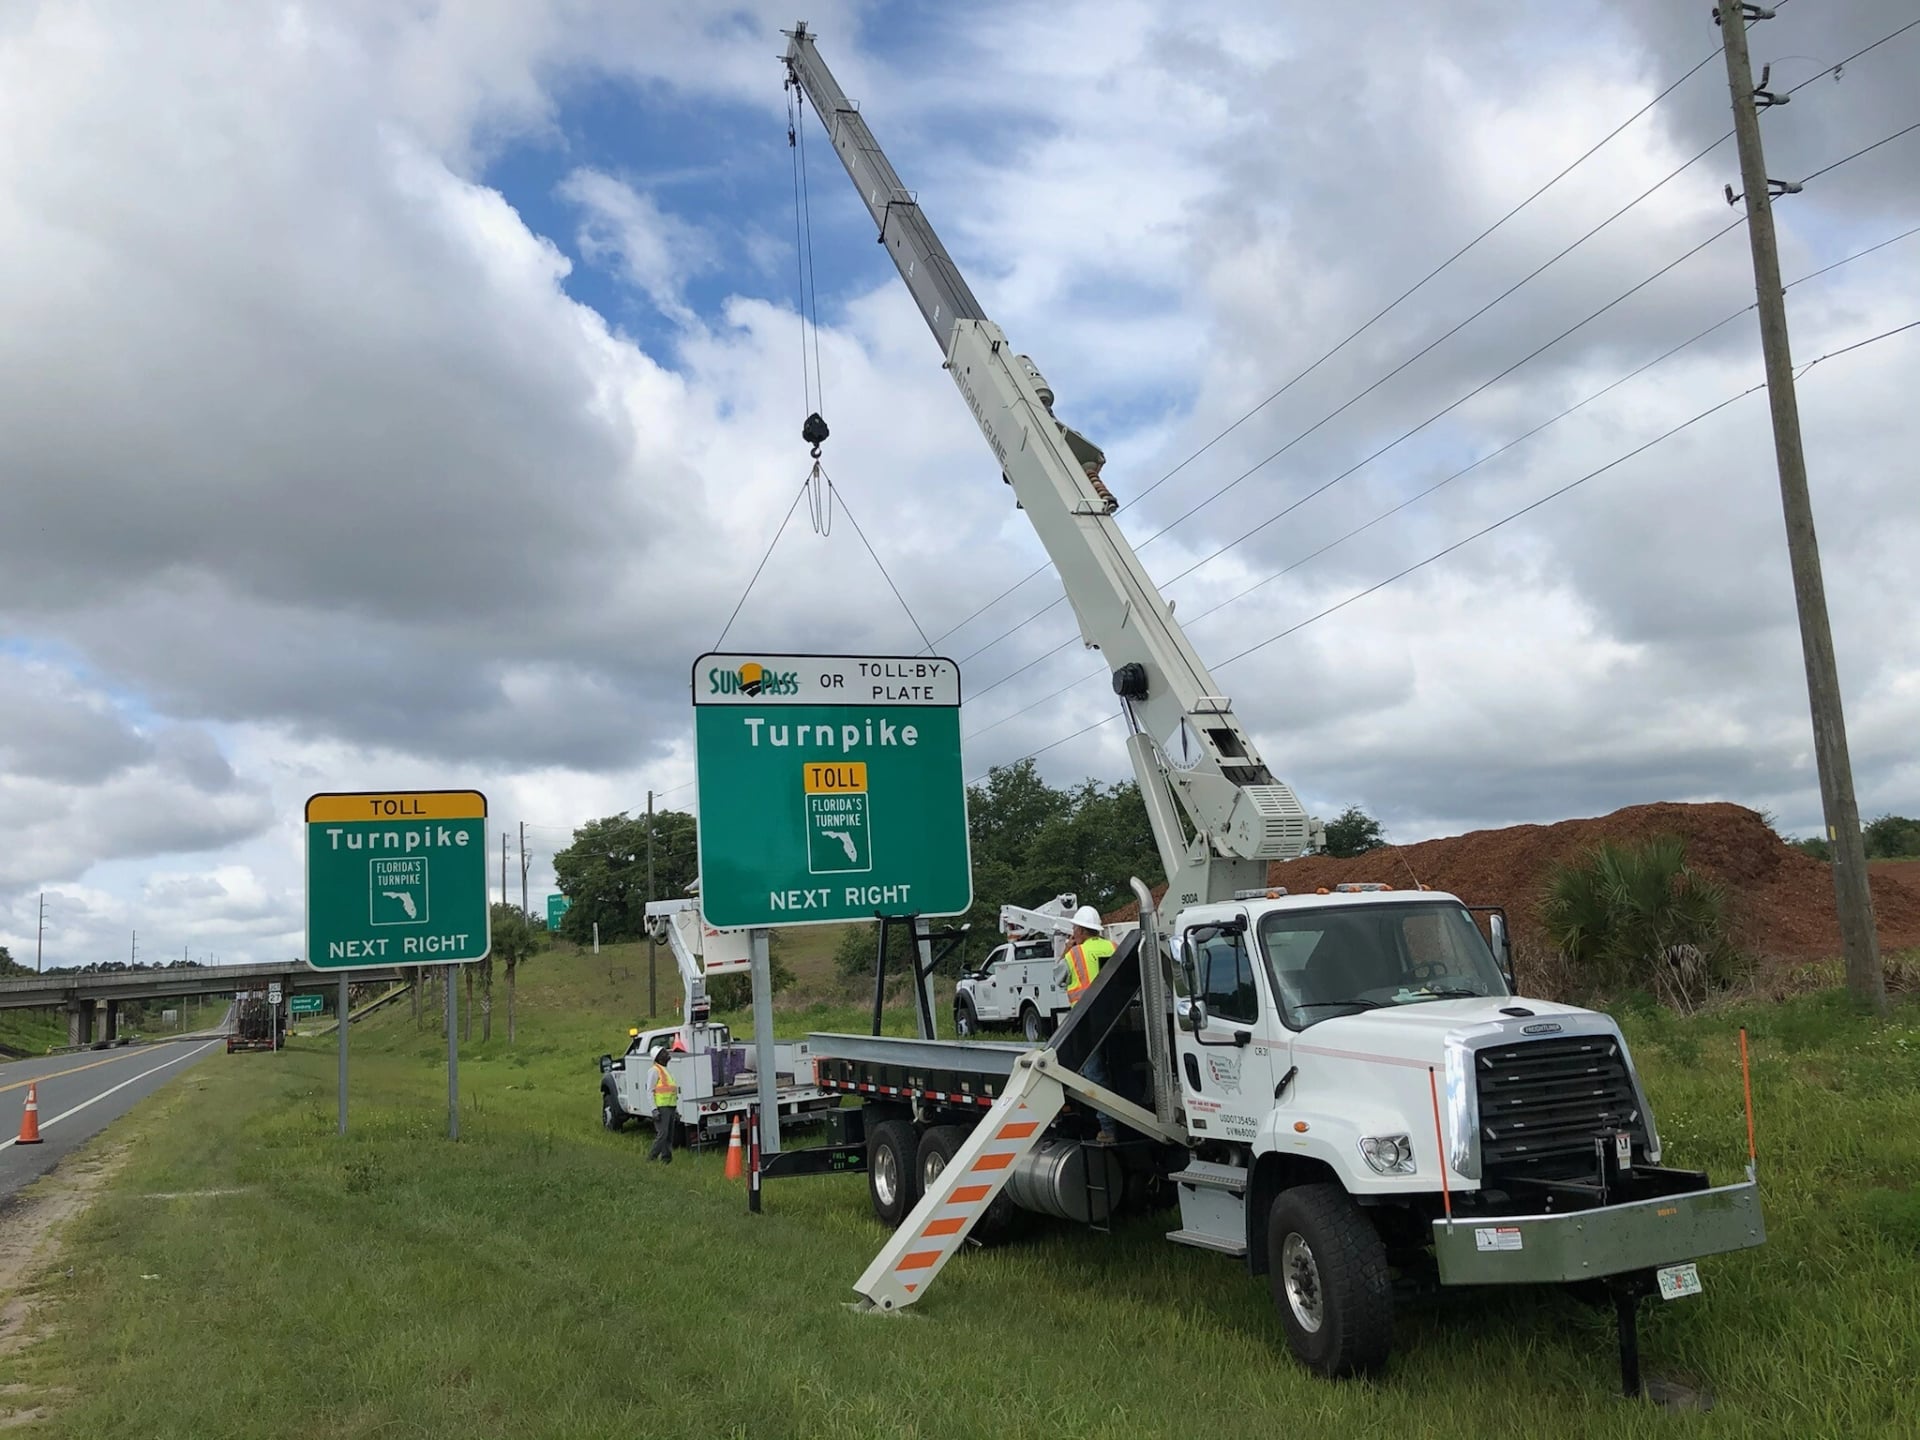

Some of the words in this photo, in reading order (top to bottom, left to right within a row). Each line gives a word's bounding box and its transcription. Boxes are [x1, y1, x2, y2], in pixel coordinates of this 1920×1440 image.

[950, 362, 984, 423] NATIONAL
[983, 419, 1008, 464] CRANE
[858, 663, 947, 679] TOLL-BY-
[820, 674, 844, 688] OR
[872, 686, 935, 700] PLATE
[744, 717, 919, 753] Turnpike
[812, 767, 860, 788] TOLL
[370, 799, 427, 816] TOLL
[812, 798, 862, 812] FLORIDA'S
[815, 813, 861, 827] TURNPIKE
[326, 826, 470, 853] Turnpike
[376, 860, 421, 873] FLORIDA'S
[377, 873, 421, 886] TURNPIKE
[770, 889, 831, 911] NEXT
[845, 885, 911, 906] RIGHT
[1181, 893, 1199, 905] 900A
[329, 938, 389, 959] NEXT
[403, 934, 469, 954] RIGHT
[270, 993, 281, 1002] 27
[1525, 1024, 1560, 1033] FREIGHTLINER
